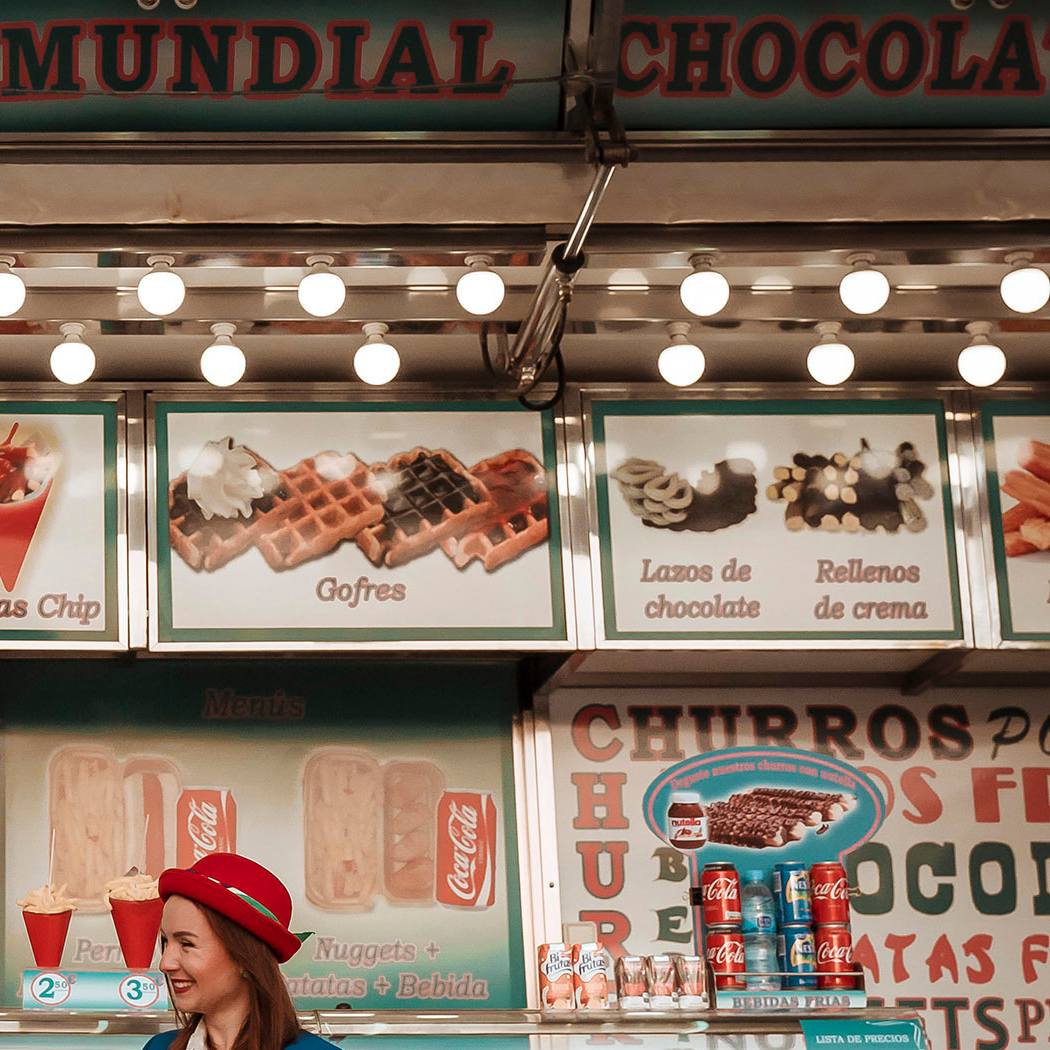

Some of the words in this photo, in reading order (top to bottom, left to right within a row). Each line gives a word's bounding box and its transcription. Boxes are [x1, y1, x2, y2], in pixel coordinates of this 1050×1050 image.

[613, 13, 1050, 98] CHOCOLA
[640, 558, 712, 583] Lazos
[721, 558, 752, 583] de
[815, 558, 921, 584] Rellenos
[316, 575, 407, 608] Gofres
[36, 593, 102, 626] Chip
[643, 592, 761, 620] chocolate
[813, 594, 846, 620] de
[851, 596, 929, 620] crema
[671, 818, 702, 826] nutella
[312, 936, 417, 968] Nuggets
[550, 953, 560, 964] Bi
[582, 953, 592, 963] Bi
[285, 973, 367, 998] atatas
[396, 972, 489, 999] Bebida
[732, 997, 798, 1008] BEBIDAS
[804, 995, 851, 1007] FRIAS
[816, 1035, 844, 1044] LISTA
[847, 1035, 862, 1043] DE
[864, 1034, 910, 1043] PRECIOS
